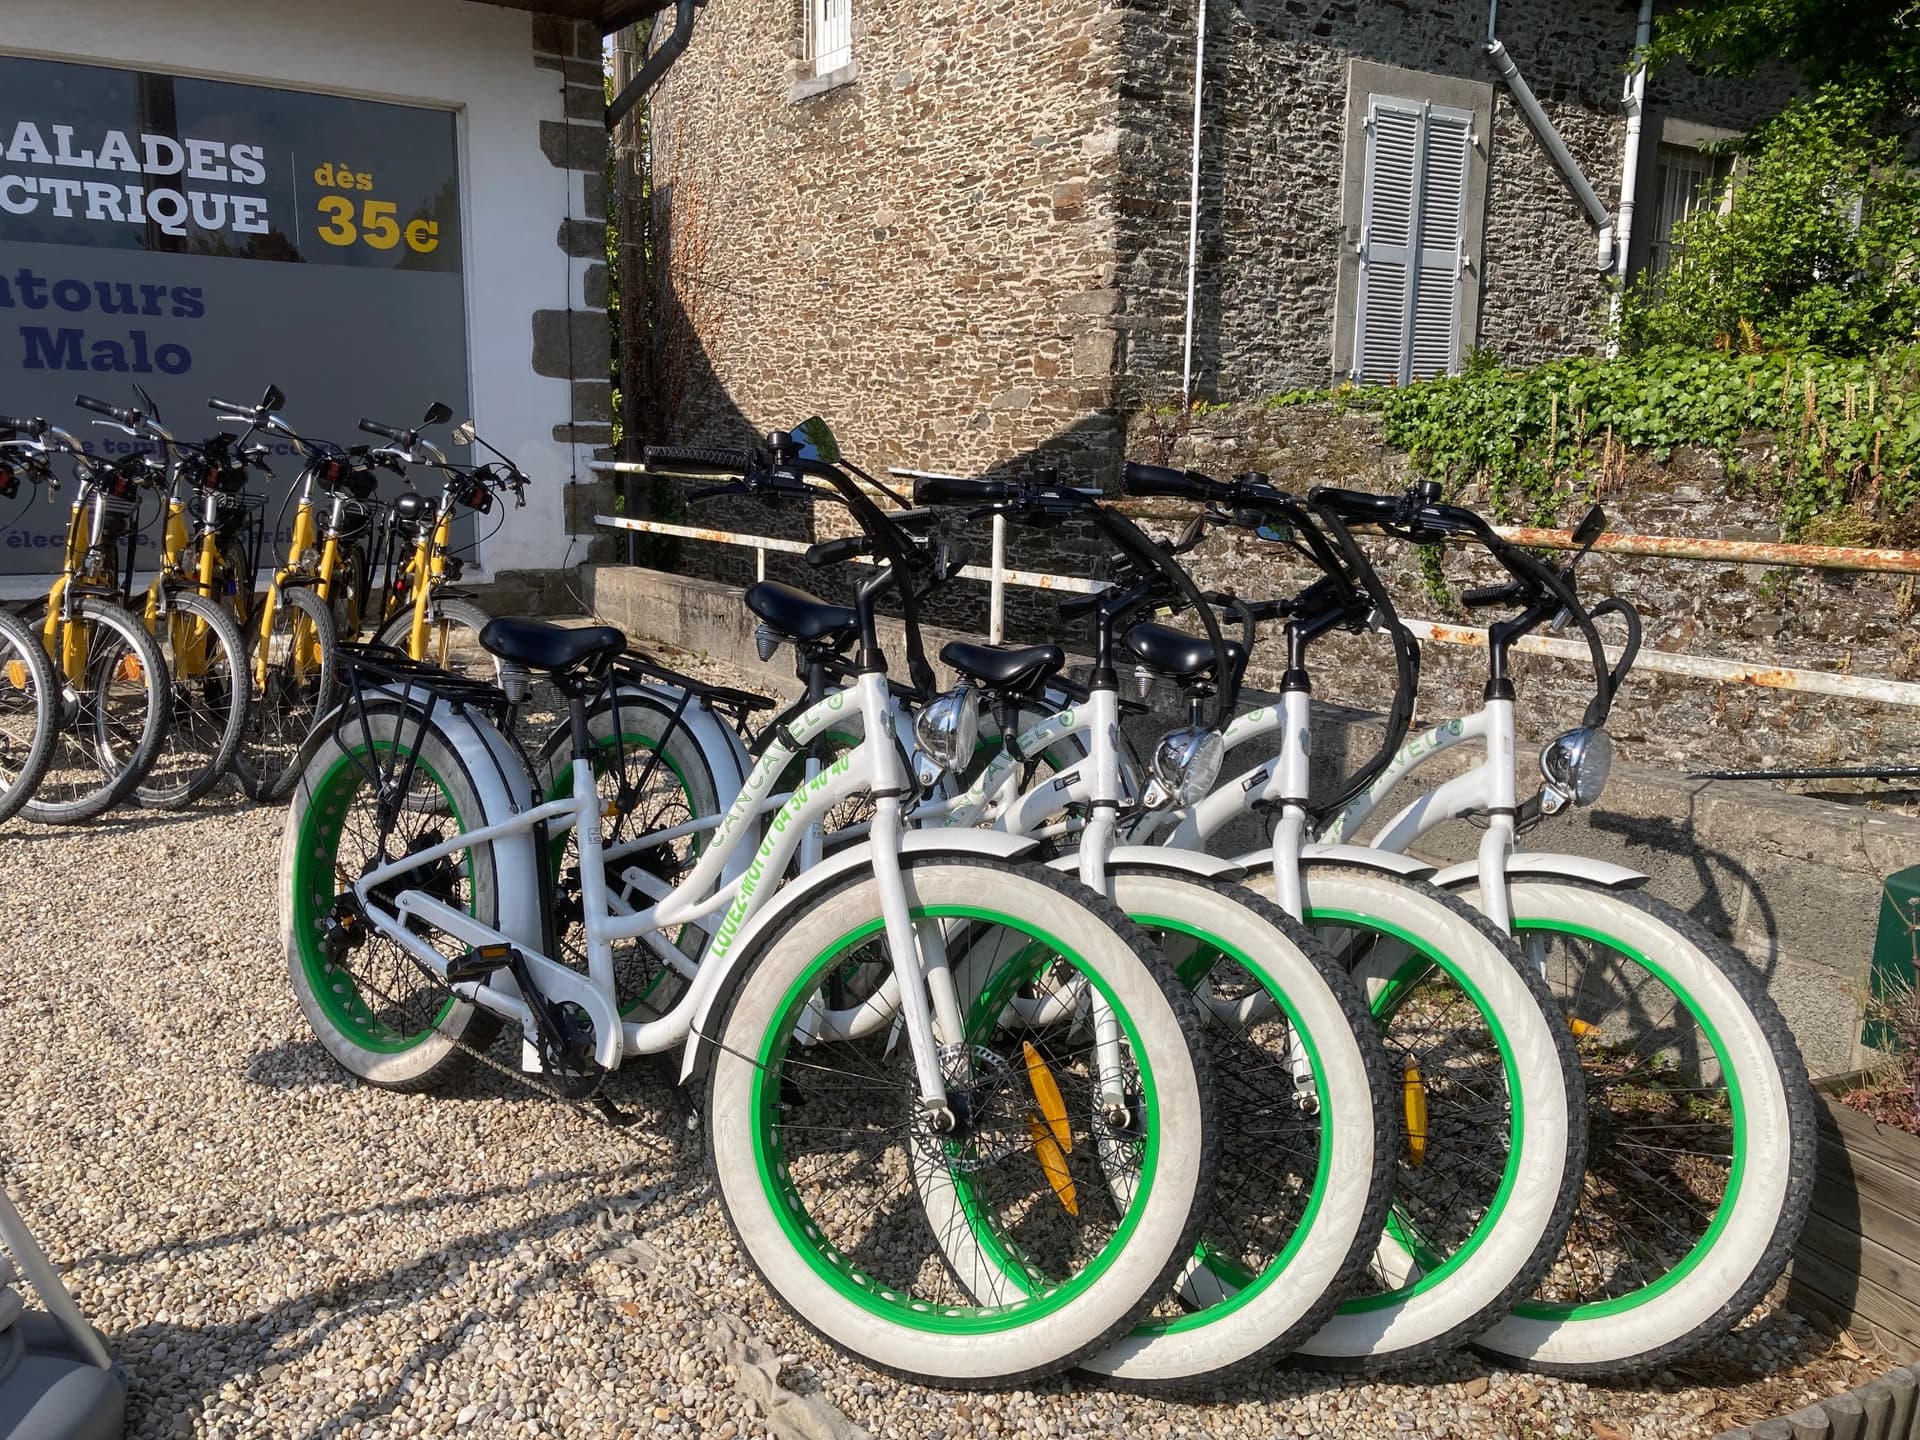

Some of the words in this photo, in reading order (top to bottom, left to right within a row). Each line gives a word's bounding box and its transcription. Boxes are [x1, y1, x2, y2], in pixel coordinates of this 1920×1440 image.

[0, 121, 266, 185] ALADES
[314, 163, 373, 191] dès
[317, 195, 439, 253] 35€
[20, 326, 192, 375] Malo
